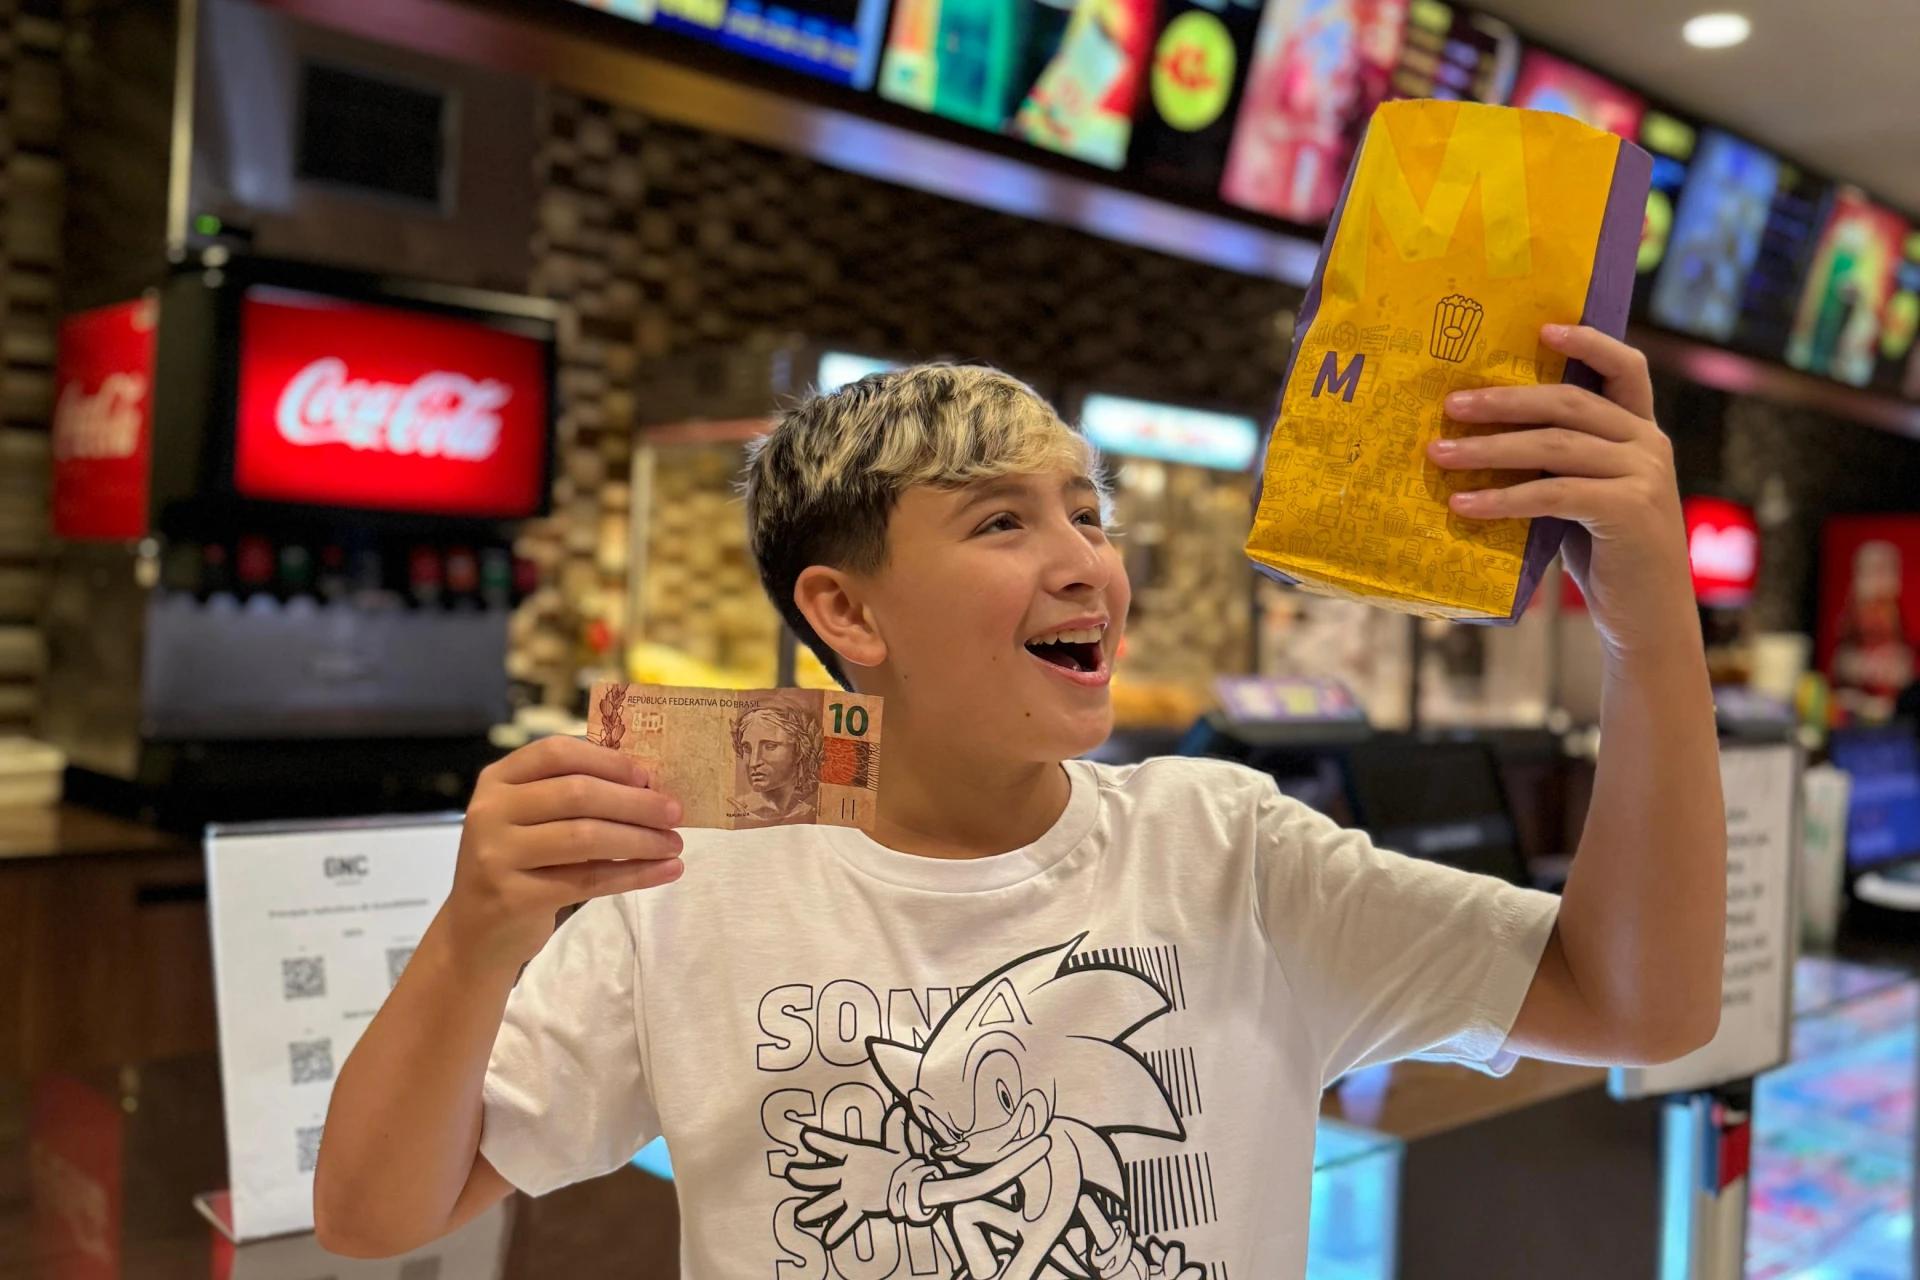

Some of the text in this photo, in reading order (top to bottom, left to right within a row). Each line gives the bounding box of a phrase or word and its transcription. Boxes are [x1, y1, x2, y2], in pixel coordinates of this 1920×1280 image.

[1311, 350, 1366, 403] M
[668, 697, 718, 707] FEDERATIVA
[719, 699, 733, 708] DO
[733, 700, 761, 710] BRASIL
[829, 703, 869, 737] 10
[756, 978, 973, 1072] SON
